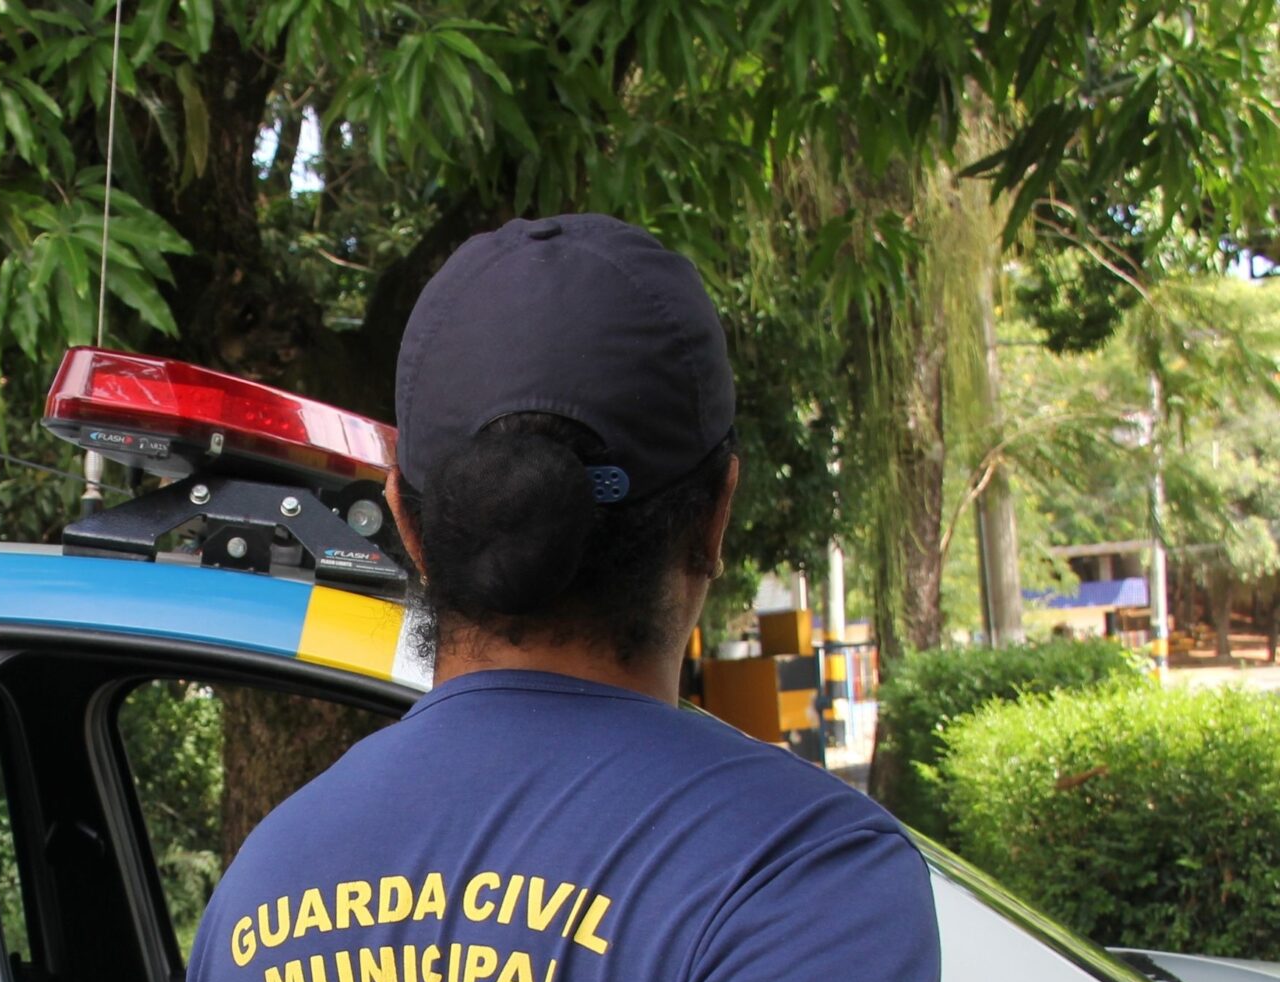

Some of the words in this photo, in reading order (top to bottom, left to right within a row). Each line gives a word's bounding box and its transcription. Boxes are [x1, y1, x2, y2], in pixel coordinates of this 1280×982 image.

[97, 432, 125, 443] FLASH
[333, 550, 370, 560] FLASH
[230, 871, 448, 968] GUARDA
[461, 871, 613, 956] CIVIL
